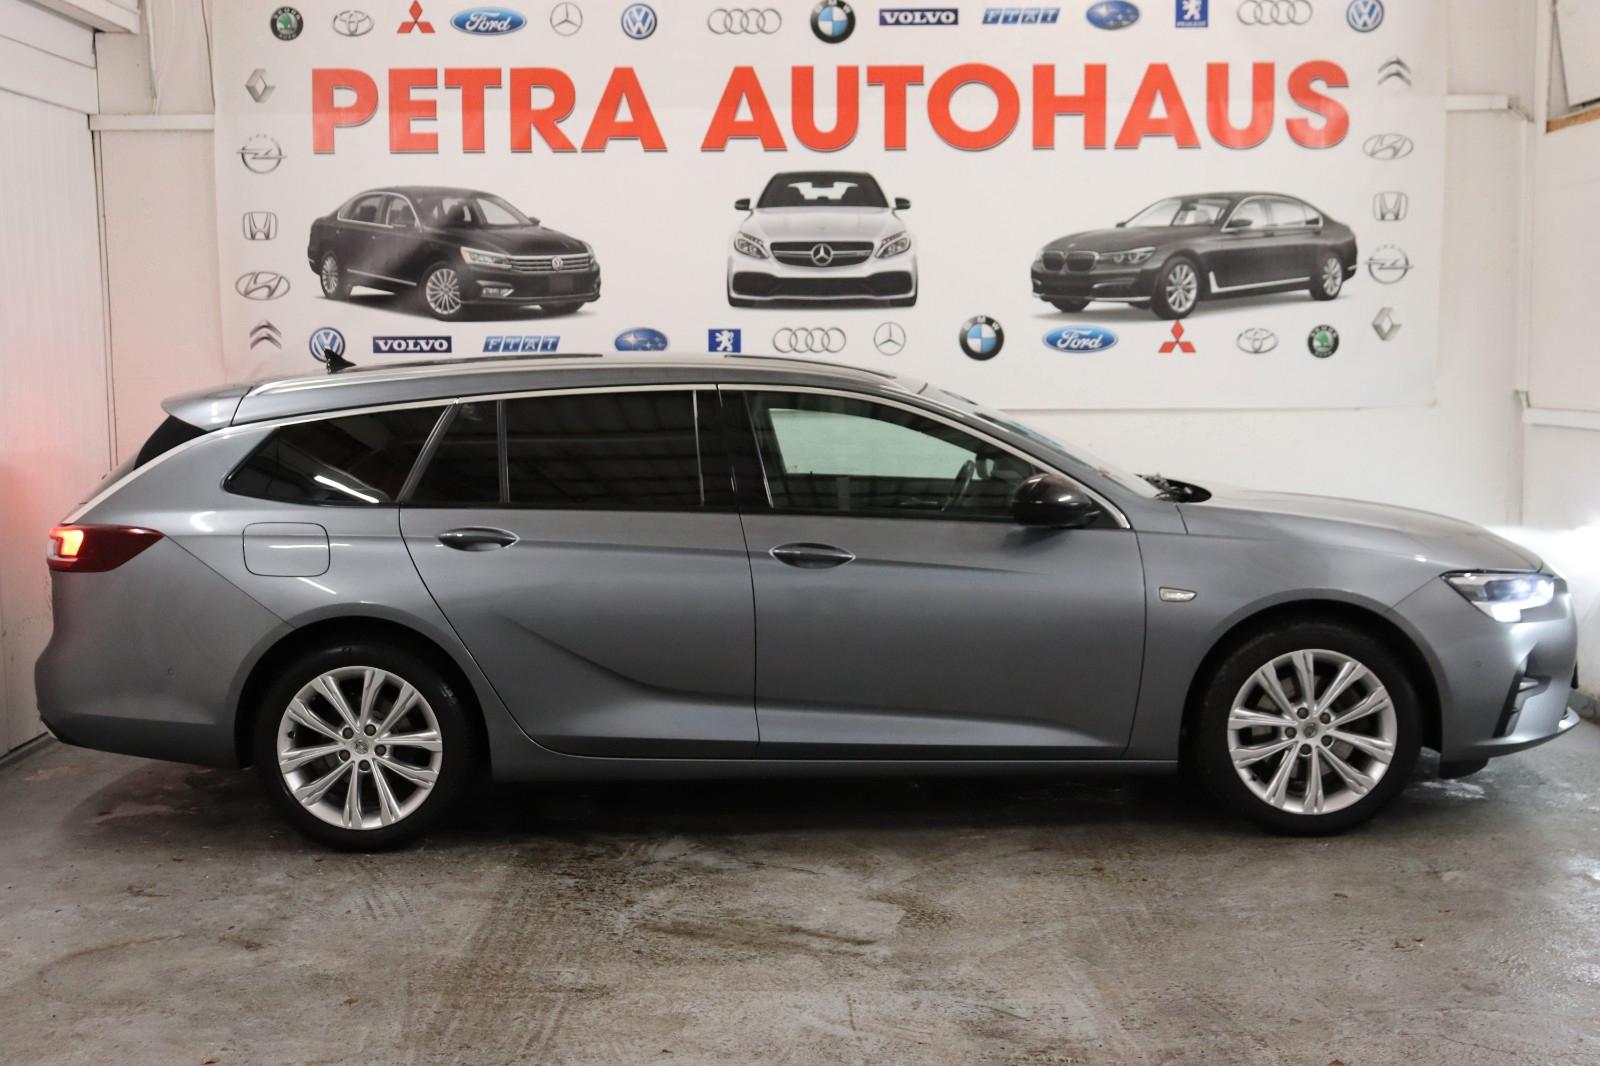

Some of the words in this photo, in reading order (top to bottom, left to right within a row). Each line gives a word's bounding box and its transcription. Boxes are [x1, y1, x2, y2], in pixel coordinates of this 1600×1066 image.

[465, 11, 511, 32] Ford
[882, 11, 956, 24] VOLVO
[312, 66, 667, 153] PETRA
[701, 60, 1350, 152] AUTOHAUS
[376, 338, 449, 352] VOLVO
[1057, 329, 1102, 350] Ford
